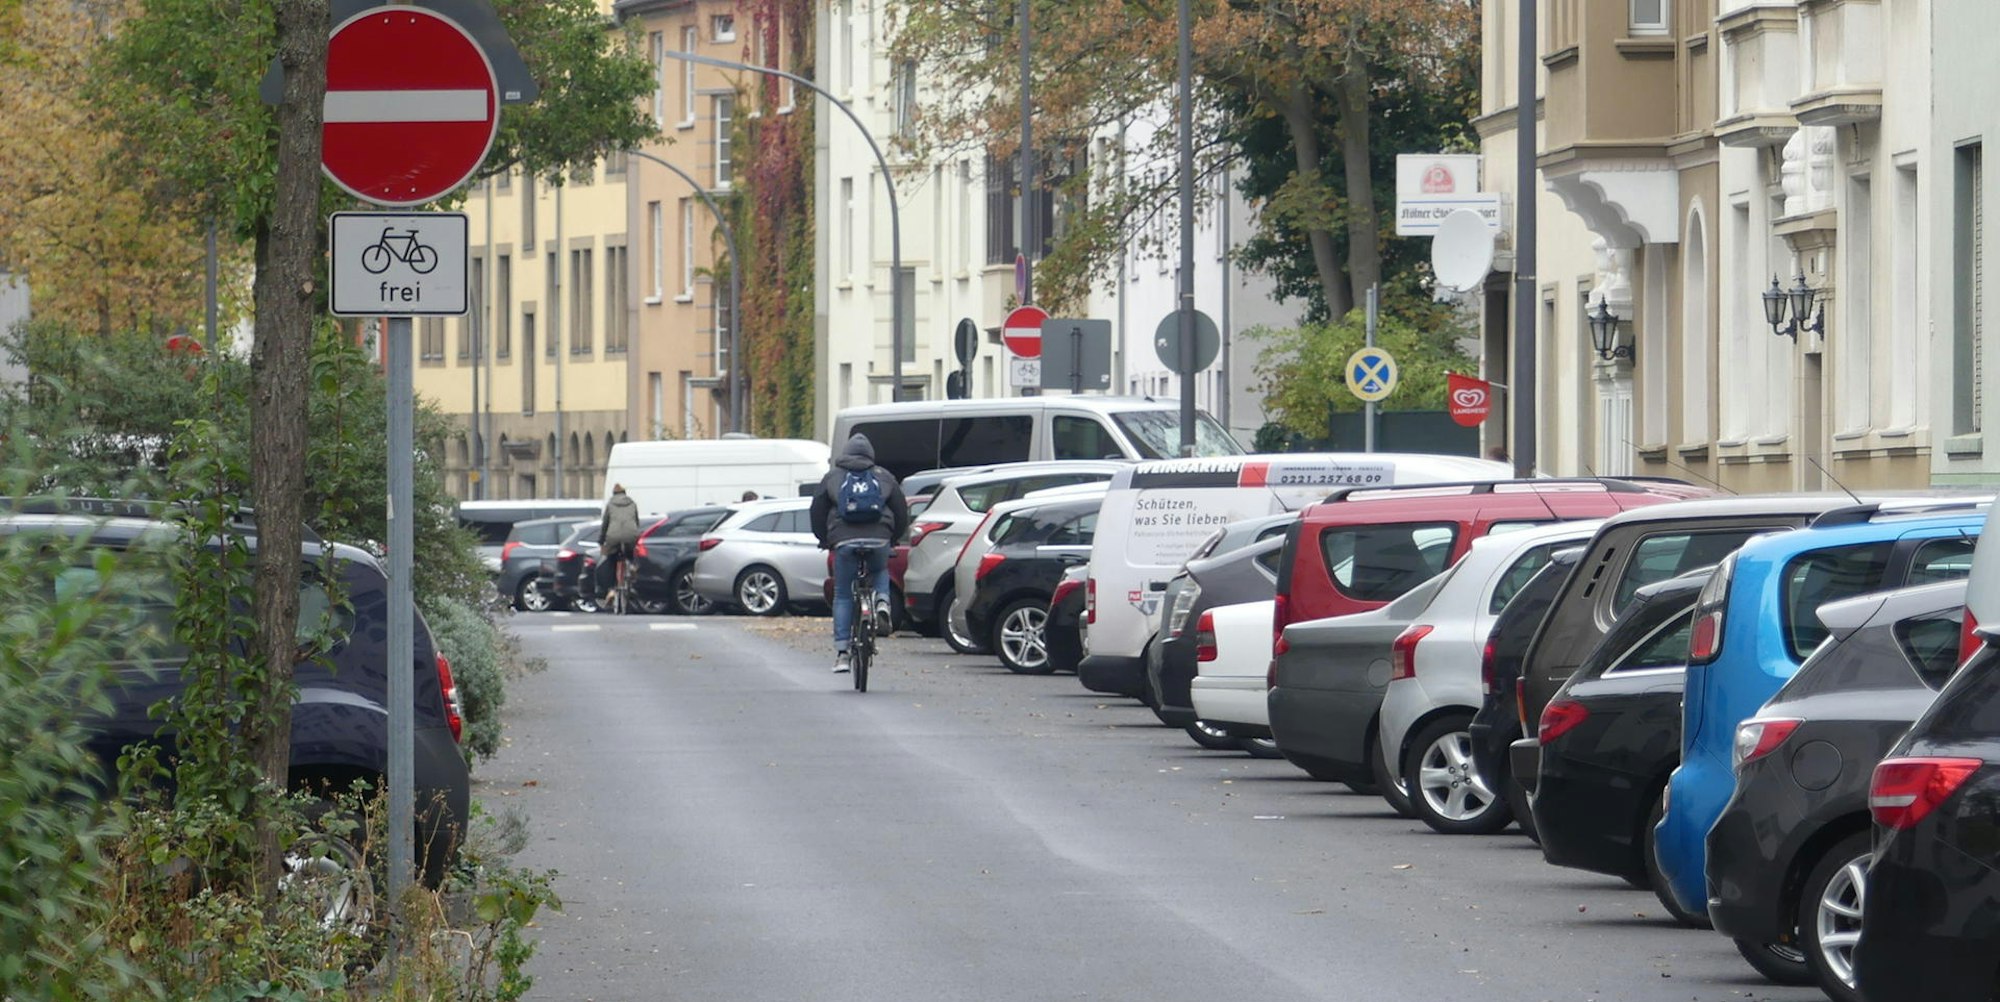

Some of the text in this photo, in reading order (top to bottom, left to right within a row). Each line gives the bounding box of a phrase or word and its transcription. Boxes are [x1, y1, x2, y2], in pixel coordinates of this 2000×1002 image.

[1401, 207, 1430, 219] Kölner
[380, 281, 420, 302] frei
[1136, 462, 1241, 474] WEINGARTEN
[1281, 474, 1382, 484] 0221.257 68 09
[1136, 498, 1198, 511] Schützen,
[1135, 513, 1227, 526] was Sie lieben
